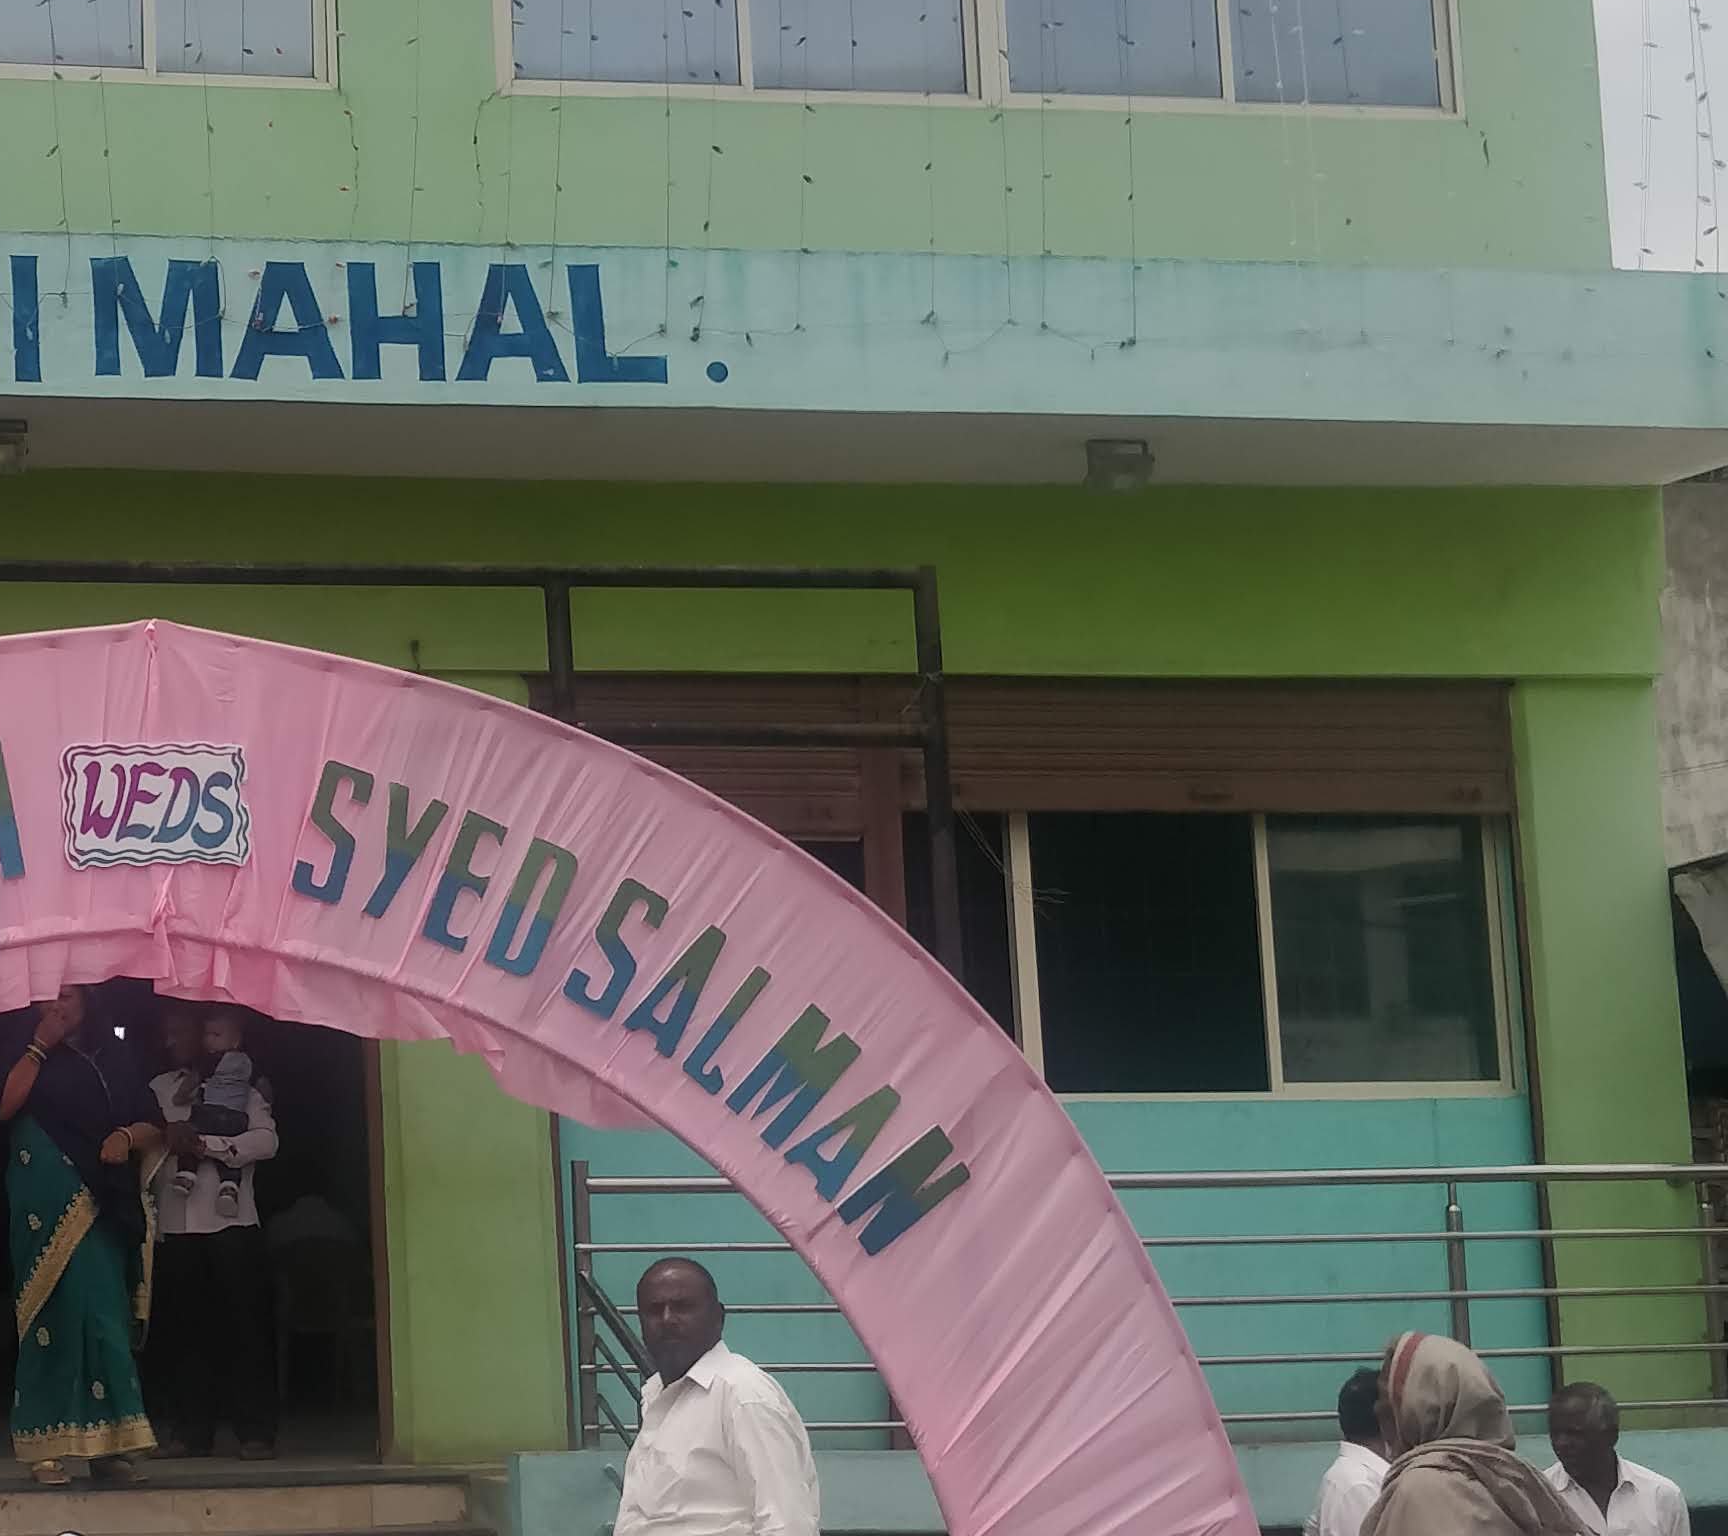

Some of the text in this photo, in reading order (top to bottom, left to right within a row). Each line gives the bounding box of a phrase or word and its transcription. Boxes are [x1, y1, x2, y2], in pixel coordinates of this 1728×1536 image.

[78, 758, 236, 850] WEDS
[290, 759, 578, 978] SYED
[562, 877, 971, 1256] SALMAN
